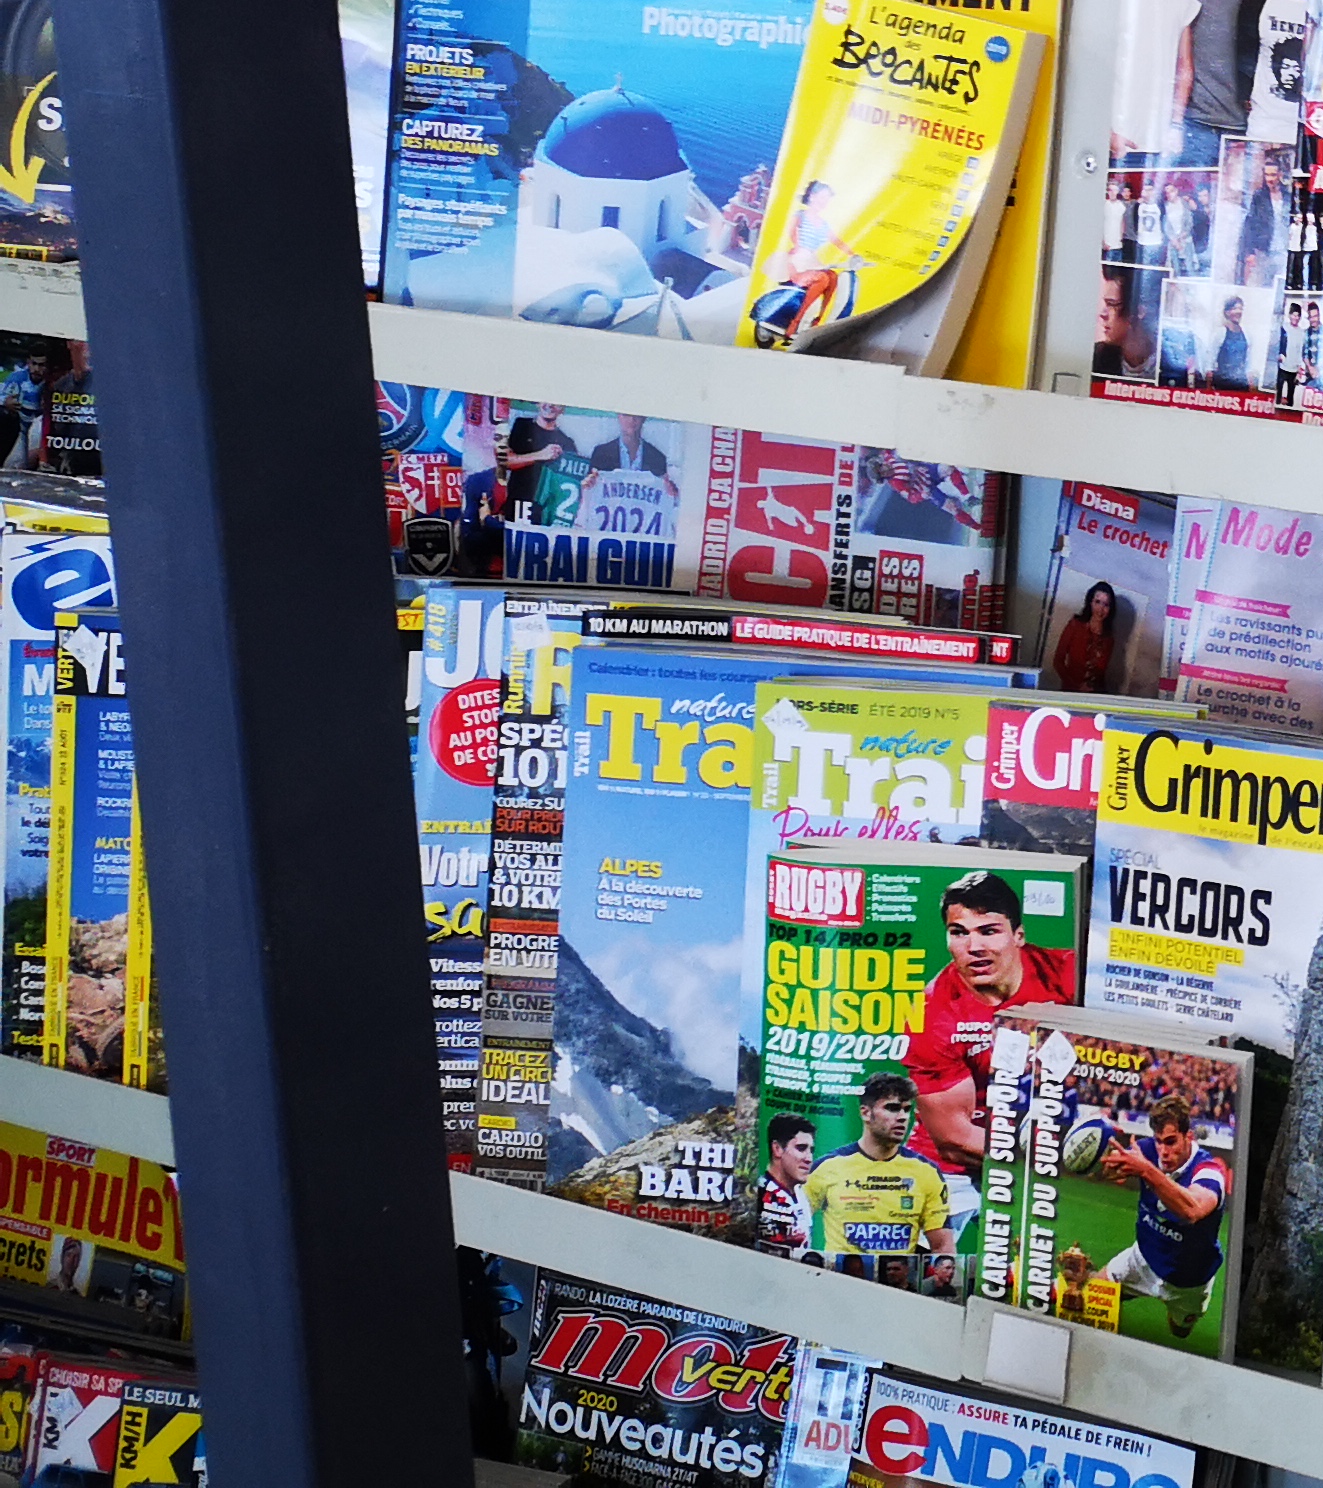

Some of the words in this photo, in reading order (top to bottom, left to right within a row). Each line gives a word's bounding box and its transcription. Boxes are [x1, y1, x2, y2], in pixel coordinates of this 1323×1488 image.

[869, 5, 967, 47] L'agenda
[406, 44, 474, 67] PROJETS
[833, 25, 980, 105] BROCANTES
[402, 118, 483, 143] CAPTUREZ
[602, 482, 663, 501] ANDERSEN
[1079, 488, 1137, 520] Diana
[1076, 512, 1101, 535] Le
[1102, 516, 1169, 560] crochet
[1221, 506, 1311, 558] Mode
[859, 730, 953, 756] nature
[774, 863, 864, 917] RUGBY
[1108, 866, 1270, 947] VERCORS
[768, 946, 926, 993] GUIDE
[766, 992, 926, 1034] SAISON
[766, 1027, 910, 1061] 2019/2020
[845, 1221, 911, 1242] PAPREC
[577, 1390, 618, 1411] 2020
[519, 1388, 764, 1477] Nouveautés
